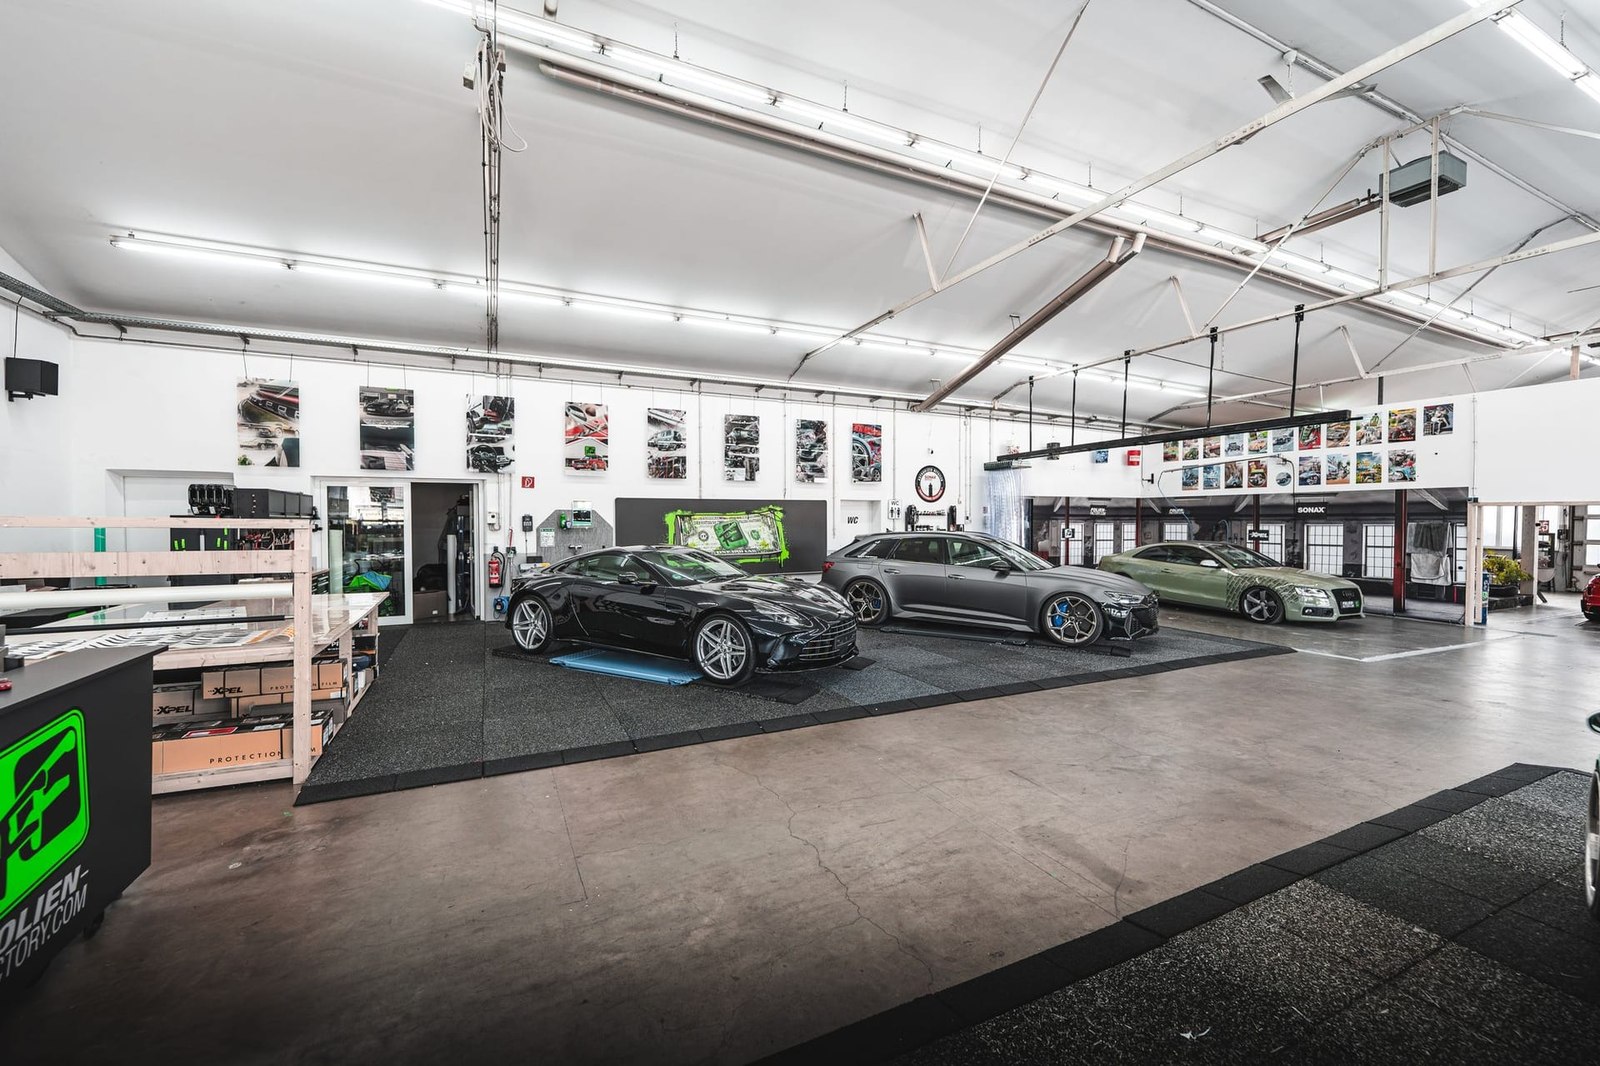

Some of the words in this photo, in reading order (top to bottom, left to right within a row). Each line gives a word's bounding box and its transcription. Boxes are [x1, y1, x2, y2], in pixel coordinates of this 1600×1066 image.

[212, 687, 243, 696] XPEL
[156, 705, 193, 715] XPEL
[209, 751, 282, 764] PROTECTION
[0, 883, 88, 980] TORY.COM
